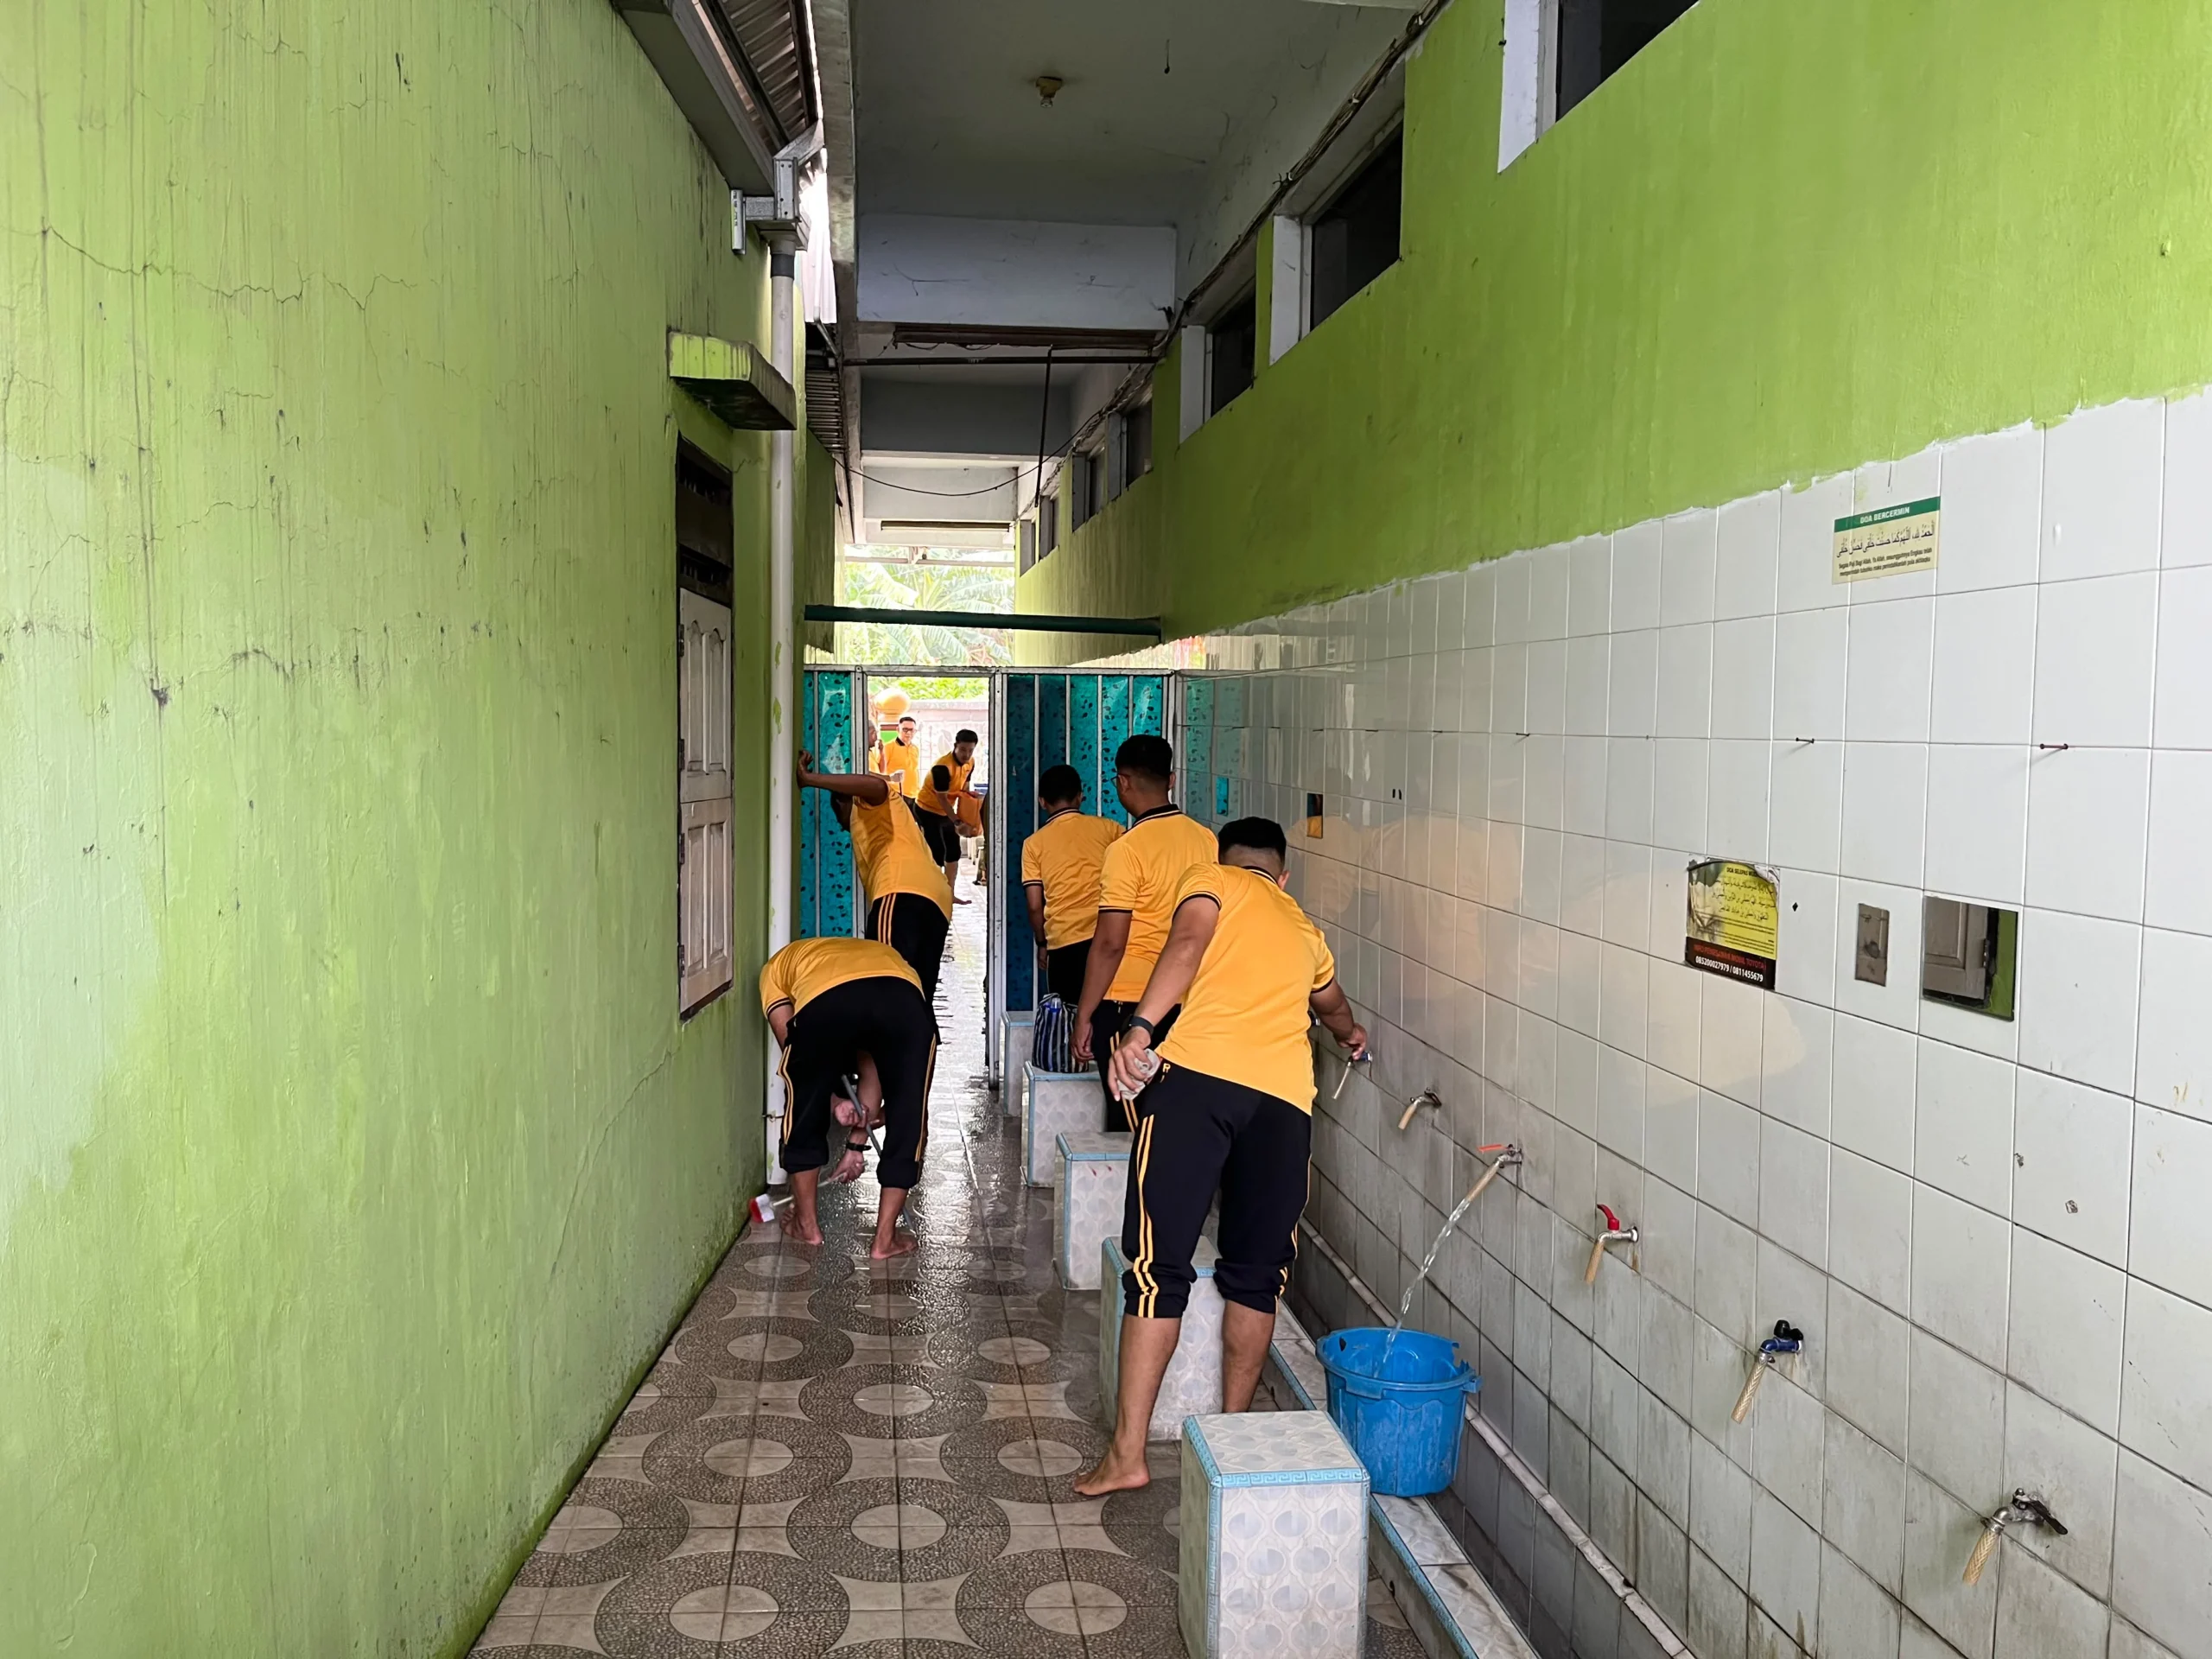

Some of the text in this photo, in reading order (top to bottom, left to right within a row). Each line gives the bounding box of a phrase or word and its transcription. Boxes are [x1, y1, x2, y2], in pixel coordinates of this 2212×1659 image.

[1859, 506, 1910, 524] DOA BERCERMIN
[1695, 956, 1730, 972] 085200027979
[1732, 966, 1764, 982] 0811455679
